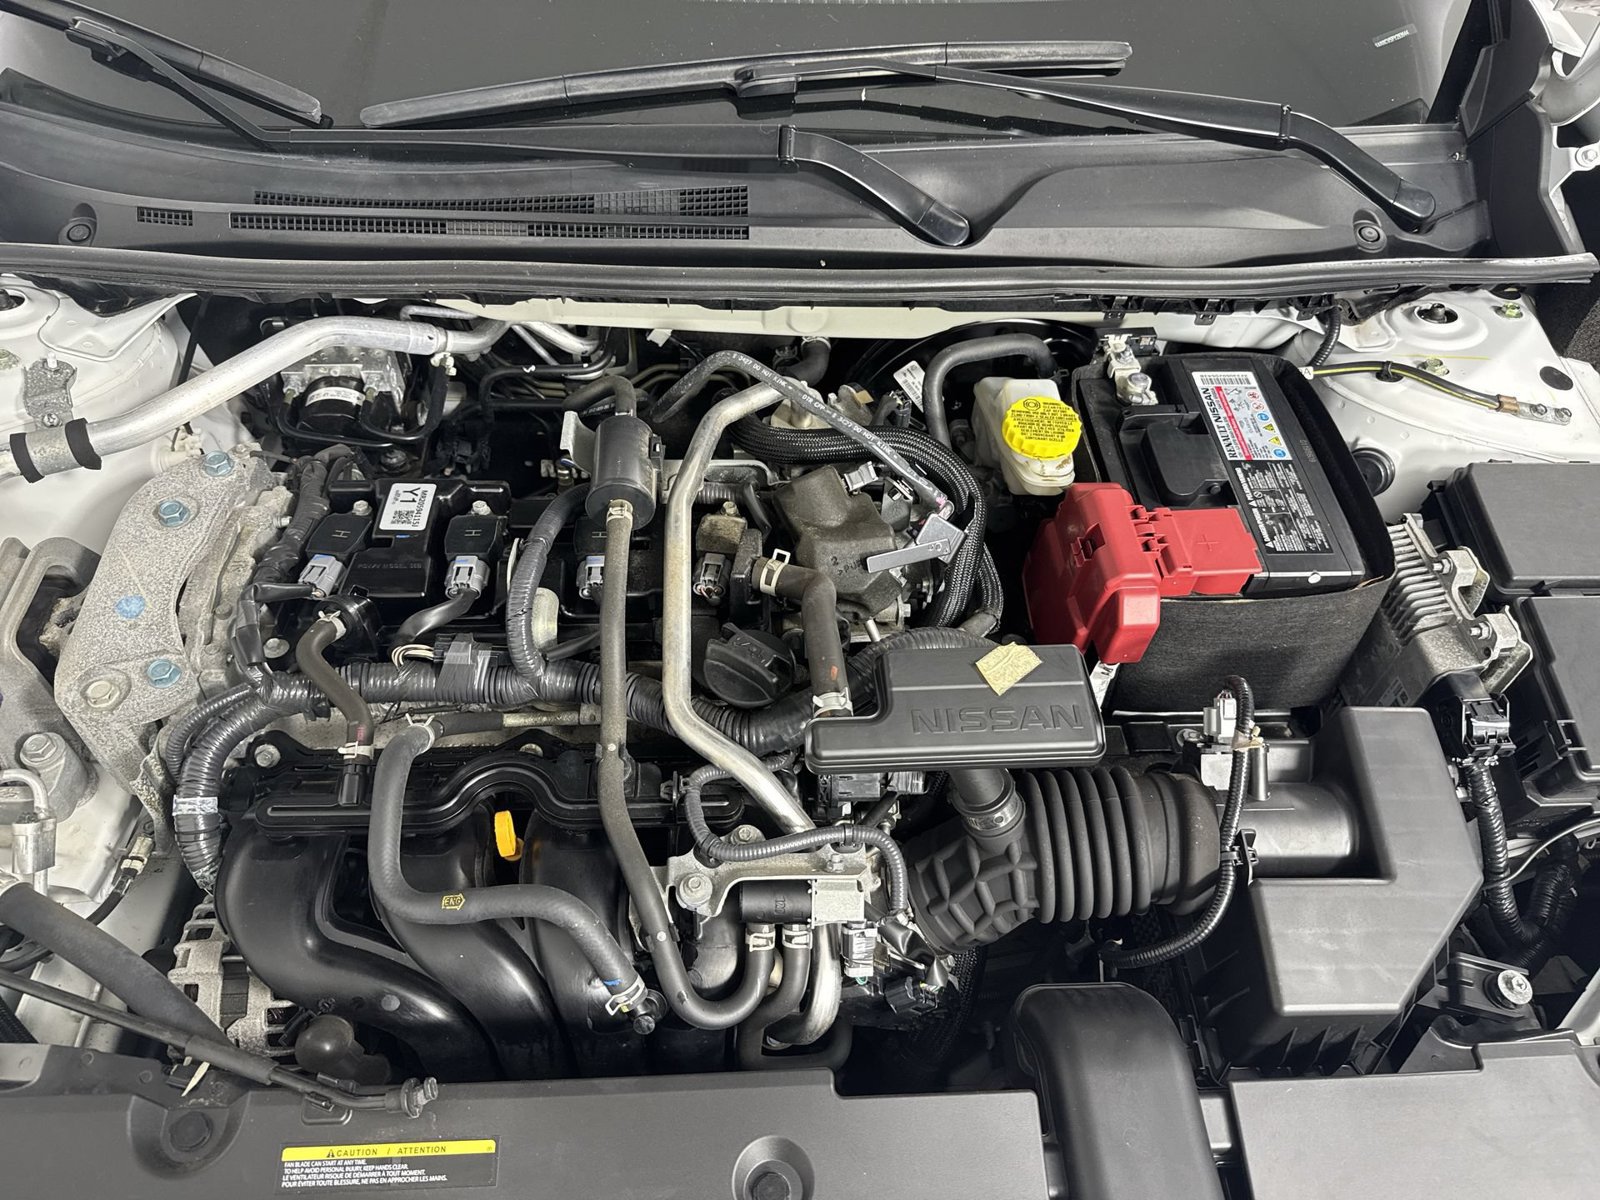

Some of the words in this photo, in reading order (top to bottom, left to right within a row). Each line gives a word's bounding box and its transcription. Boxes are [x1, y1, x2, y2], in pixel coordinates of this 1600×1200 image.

[1201, 387, 1223, 423] NISSAN
[1216, 424, 1238, 458] RENAULT
[400, 487, 421, 502] Y1
[911, 704, 1084, 734] NISSAN
[445, 897, 460, 905] ENG
[337, 1148, 378, 1157] CAUTION
[397, 1146, 447, 1154] ATTENTION
